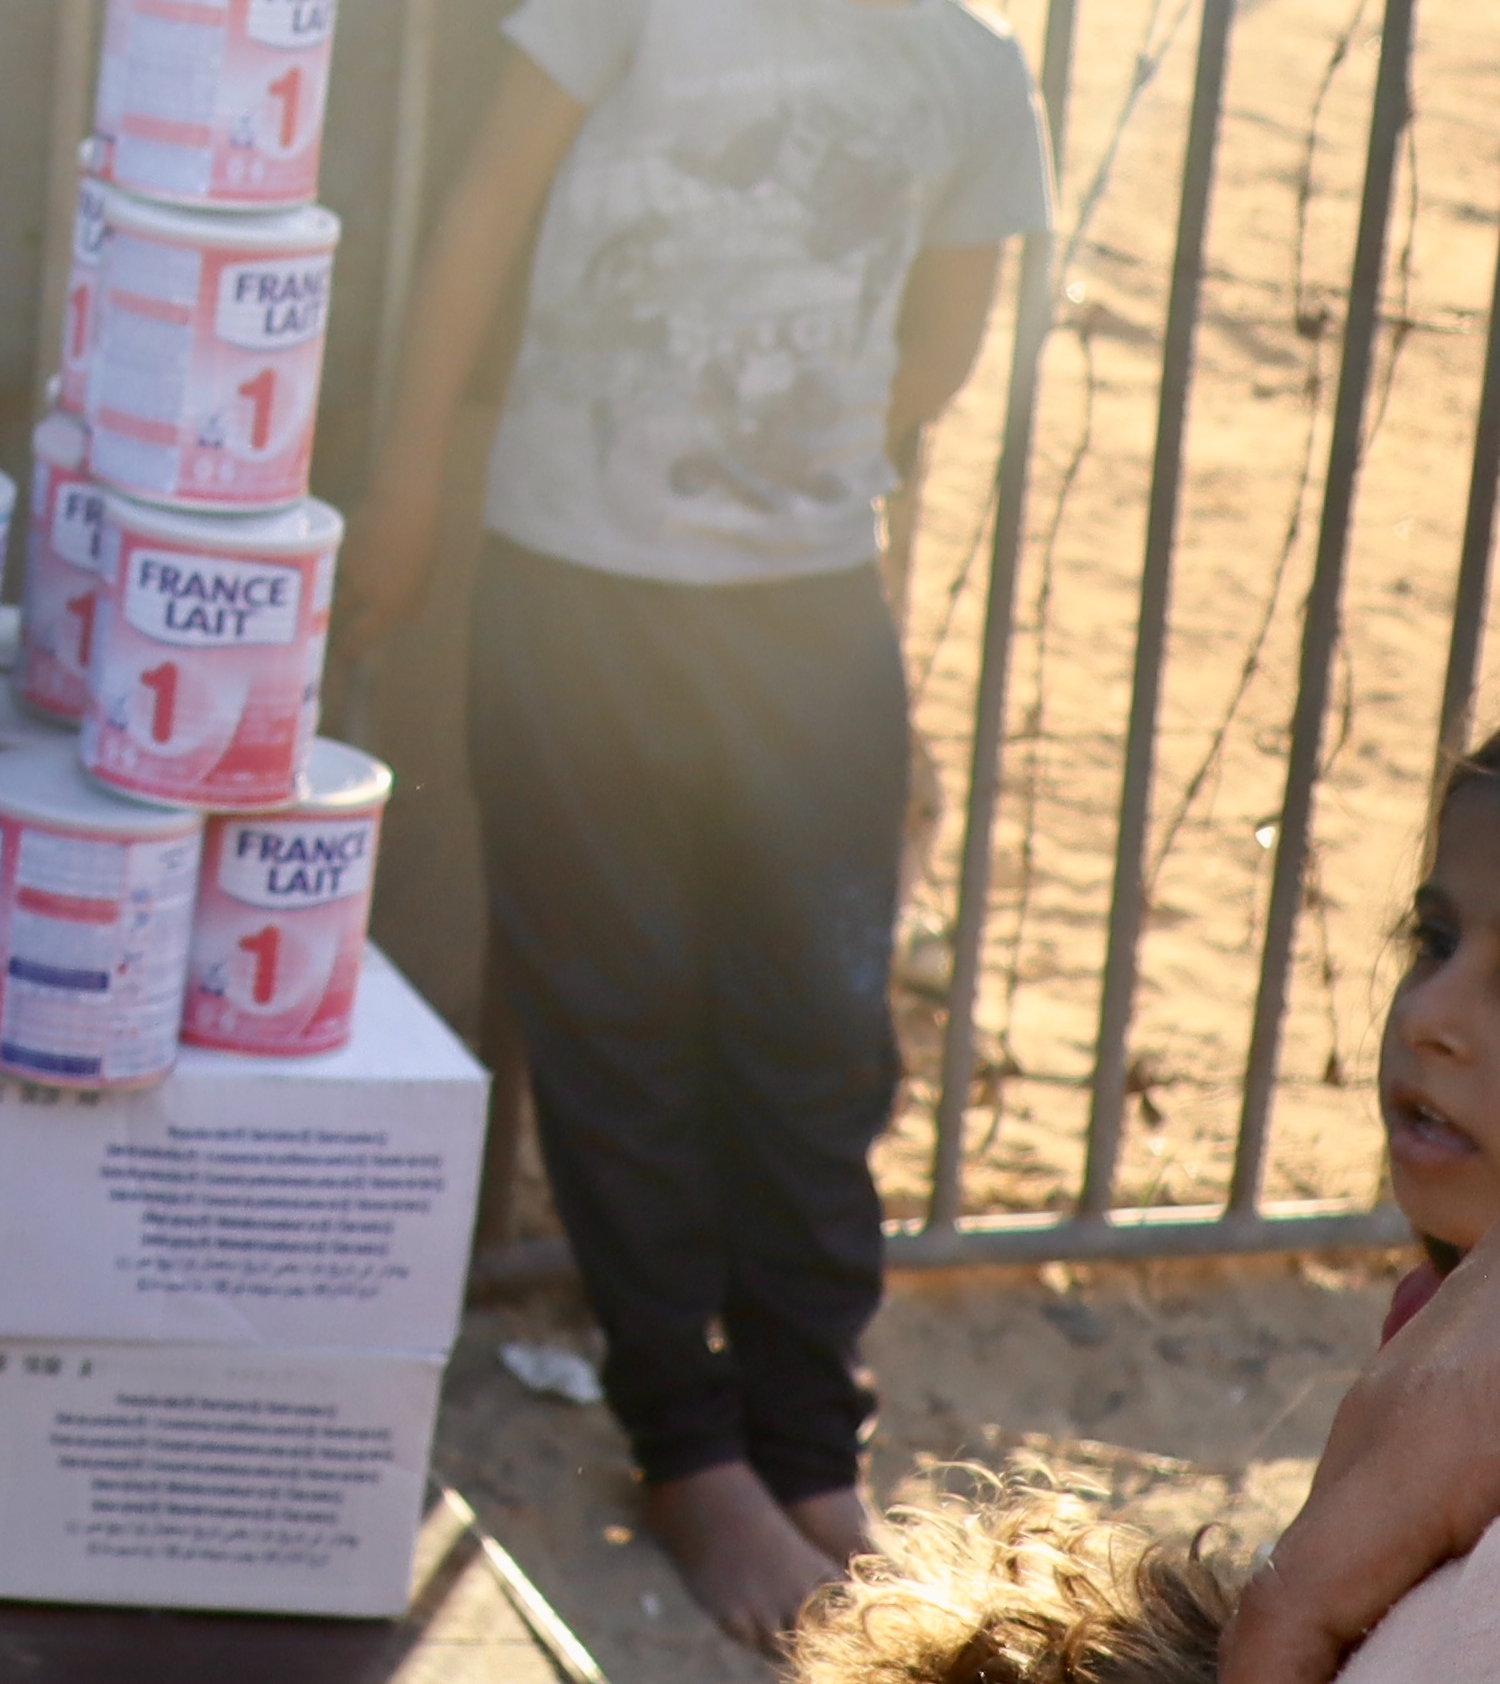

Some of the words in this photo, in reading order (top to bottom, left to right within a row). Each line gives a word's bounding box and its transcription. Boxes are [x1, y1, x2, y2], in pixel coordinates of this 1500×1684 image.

[268, 67, 302, 149] 1
[238, 368, 277, 452] 1
[138, 559, 291, 608] FRANCE
[164, 600, 251, 638] LAIT
[66, 590, 96, 668] 1
[139, 661, 179, 744] 1
[267, 865, 345, 895] LAIT
[239, 925, 280, 1005] 1
